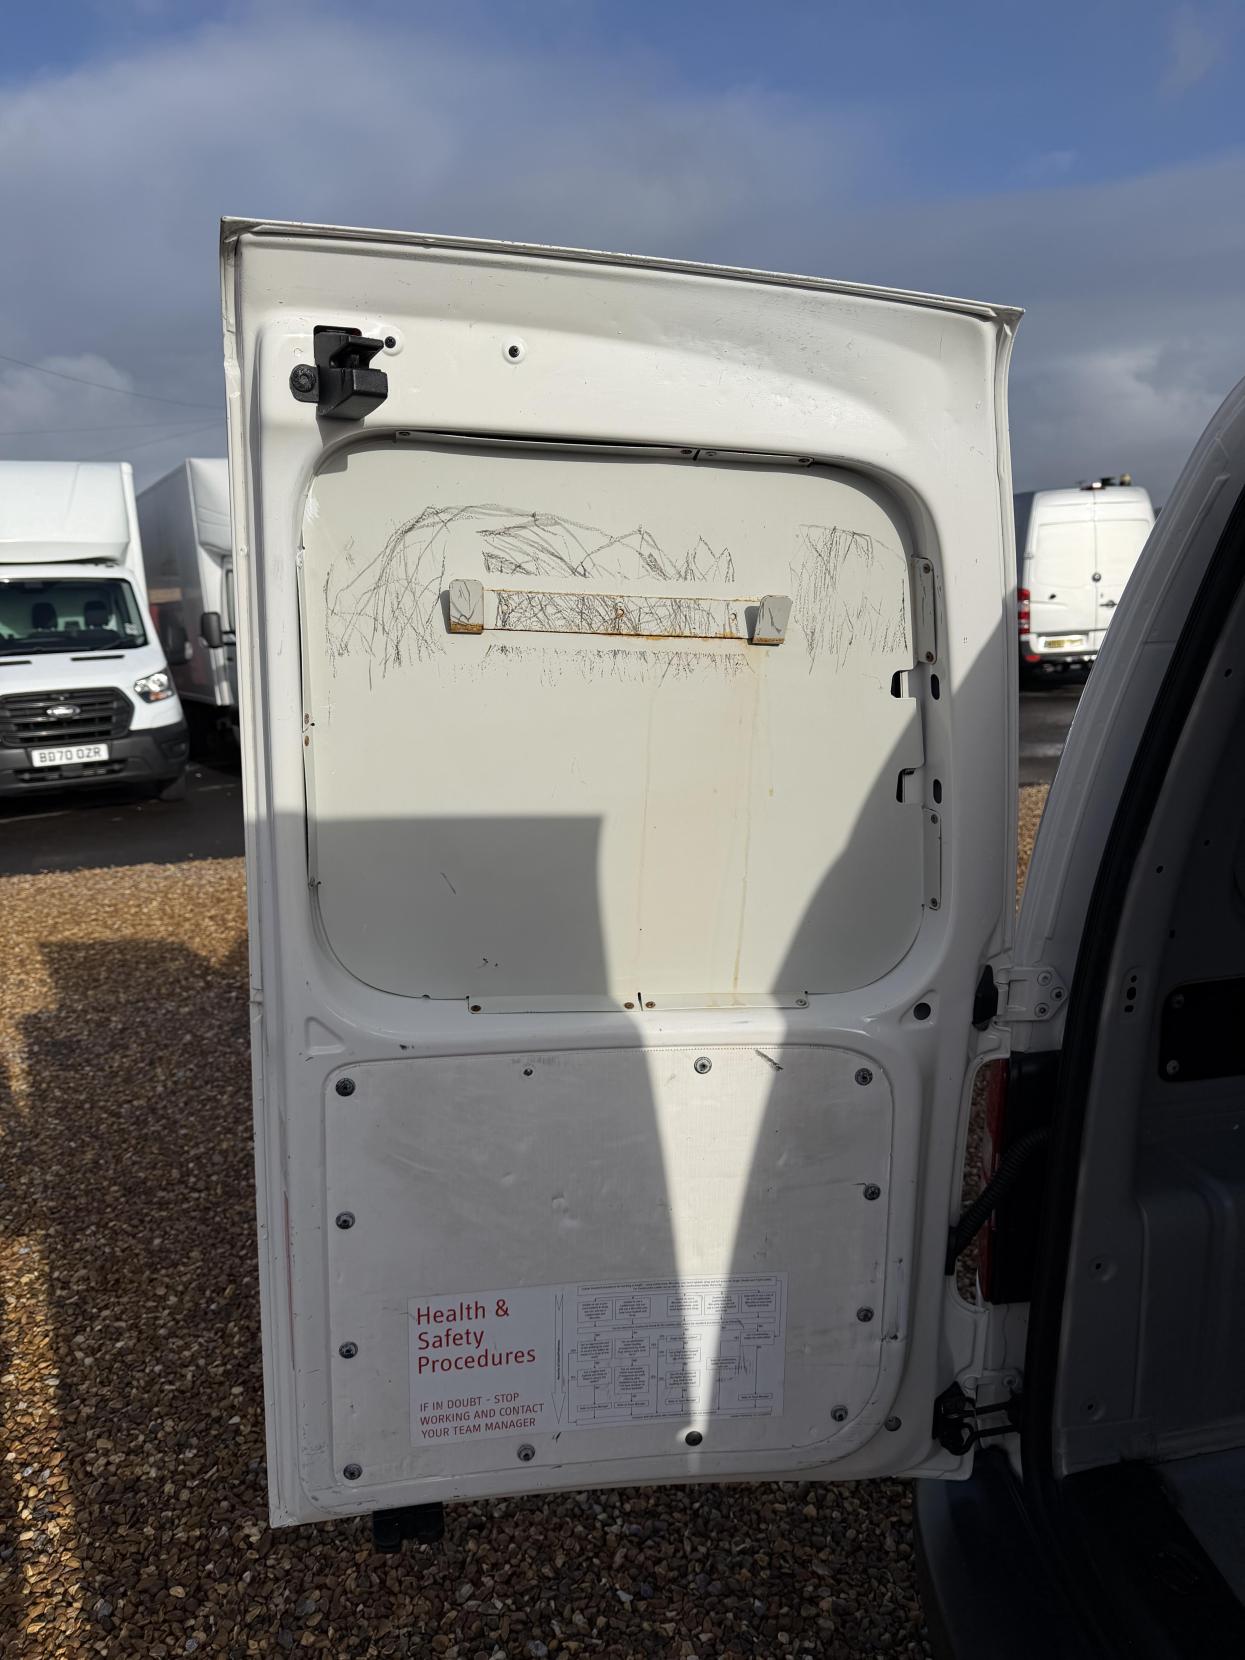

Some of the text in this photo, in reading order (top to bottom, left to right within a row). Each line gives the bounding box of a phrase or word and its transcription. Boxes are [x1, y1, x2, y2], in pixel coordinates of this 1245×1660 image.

[39, 749, 73, 763] BD70
[417, 1298, 510, 1325] Health &
[418, 1328, 484, 1350] Safety
[418, 1348, 536, 1374] Procedures
[420, 1402, 429, 1412] IF
[432, 1401, 443, 1411] IN
[447, 1396, 482, 1409] DOUBT
[494, 1392, 520, 1404] STOP
[420, 1403, 545, 1426] WORKING AND CONTACT
[421, 1417, 536, 1439] YOUR TEAM MANAGER
